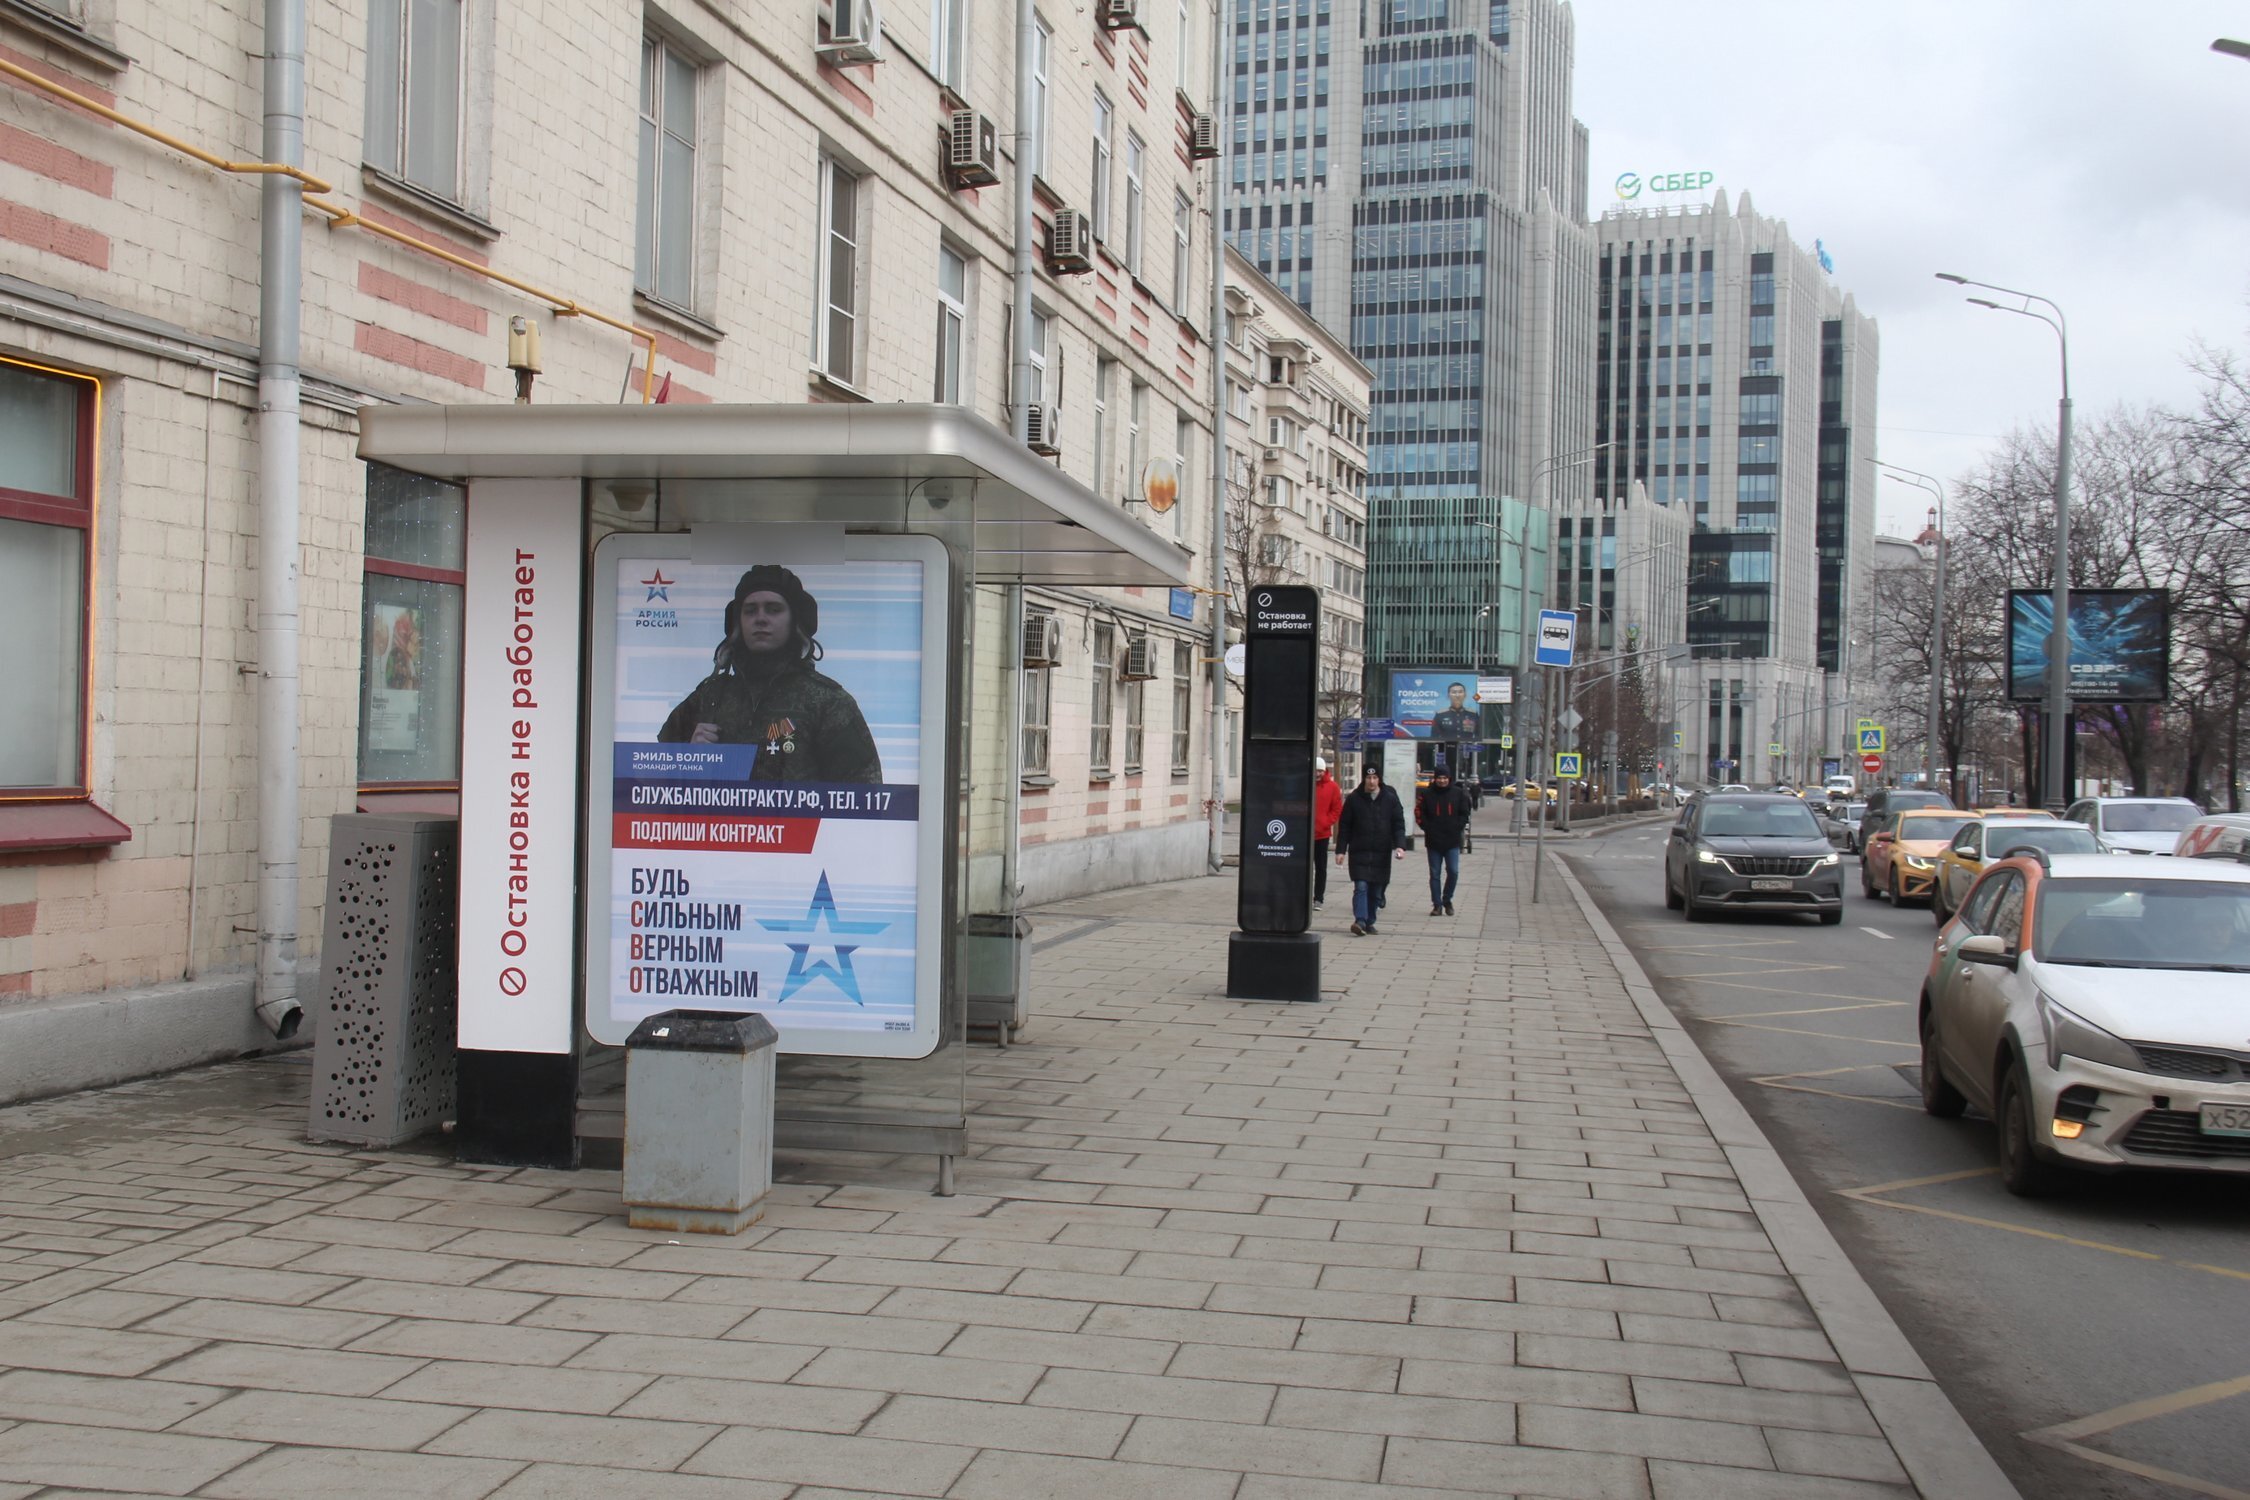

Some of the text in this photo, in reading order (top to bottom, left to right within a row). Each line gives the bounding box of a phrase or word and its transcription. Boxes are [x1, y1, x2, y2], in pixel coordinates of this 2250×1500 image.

[1650, 171, 1714, 192] СБЕР
[635, 620, 678, 628] РОССИИ
[638, 610, 676, 619] АРМИЯ
[1258, 611, 1307, 620] Остановка
[1271, 621, 1313, 630] работает
[1398, 690, 1440, 698] ГОРДОСТЬ
[500, 548, 538, 957] Остановка не работает
[632, 752, 723, 762] ЭМИЛЬ ВОЛГИН
[632, 763, 677, 771] КОМАНДИР
[631, 785, 891, 812] СЛУЖБАПОКОНТРАКТУ.РФ, ТЕЛ. 117
[630, 820, 785, 844] ПОДПИШИ КОНТРАКТ
[631, 868, 690, 898] БУДЬ
[630, 900, 741, 931] СИЛЬНЫМ
[630, 933, 723, 963] ВЕРНЫМ
[629, 966, 758, 998] ОТВАЖНЫМ
